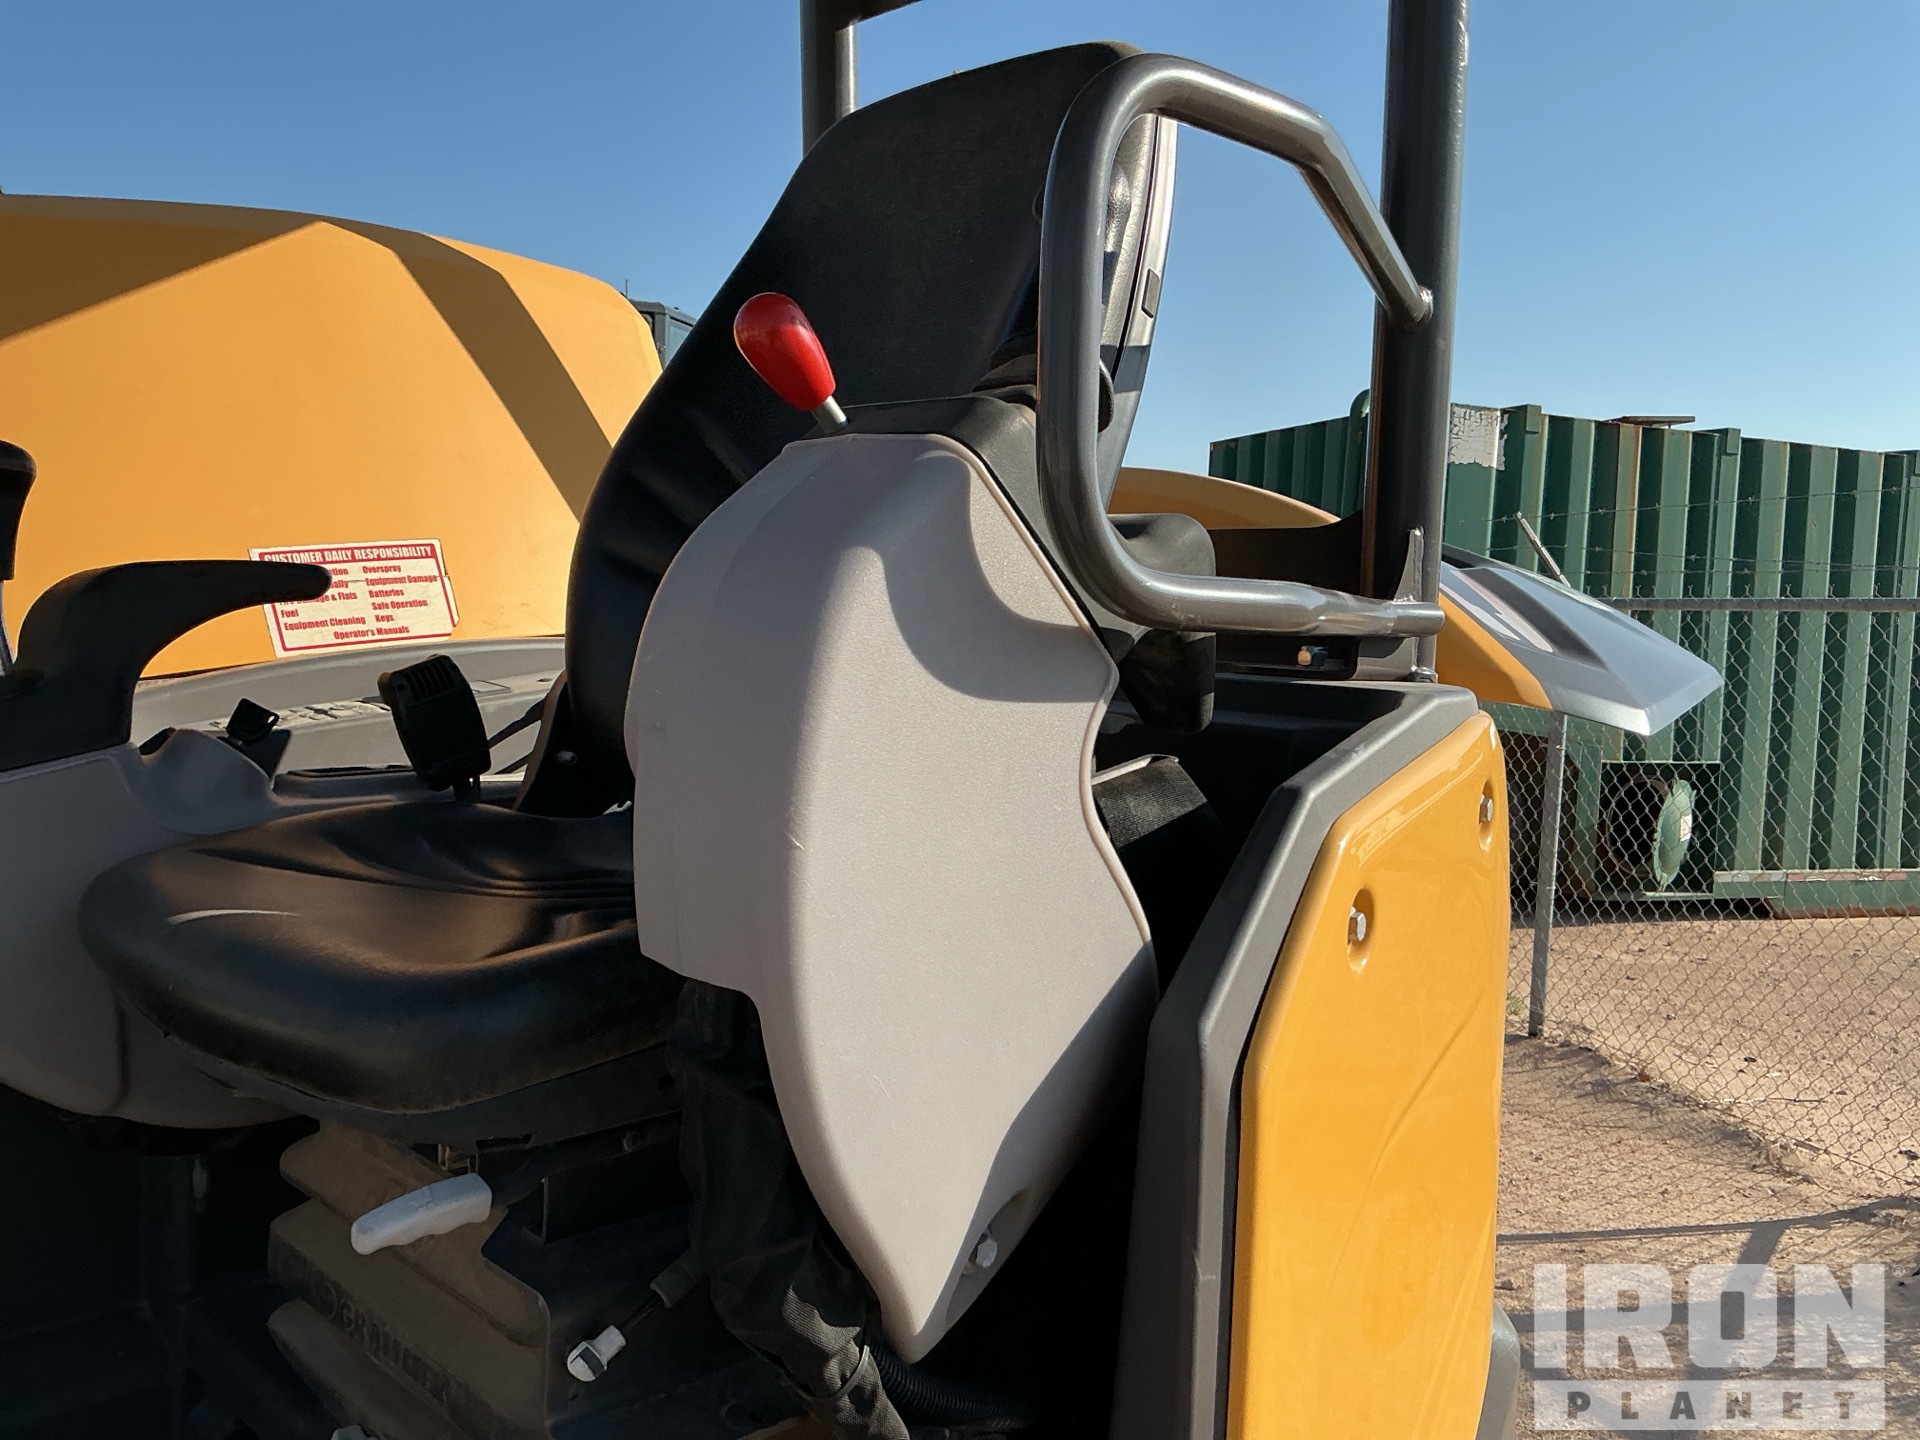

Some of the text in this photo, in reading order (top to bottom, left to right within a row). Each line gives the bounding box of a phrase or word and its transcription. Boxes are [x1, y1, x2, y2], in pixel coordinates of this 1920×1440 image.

[264, 546, 431, 563] CUSTOMER DAILY RESPONSIBILITY
[362, 565, 401, 575] Overspray
[365, 574, 438, 587] Equipment Damage
[331, 593, 338, 601] &
[338, 591, 358, 601] Flats
[368, 589, 405, 599] Batteries
[372, 599, 428, 611] Safe Operation
[281, 609, 299, 618] Fuel
[375, 613, 395, 623] Keys
[284, 616, 366, 631] Equipment Cleaning
[333, 625, 410, 640] Operator's Manuals
